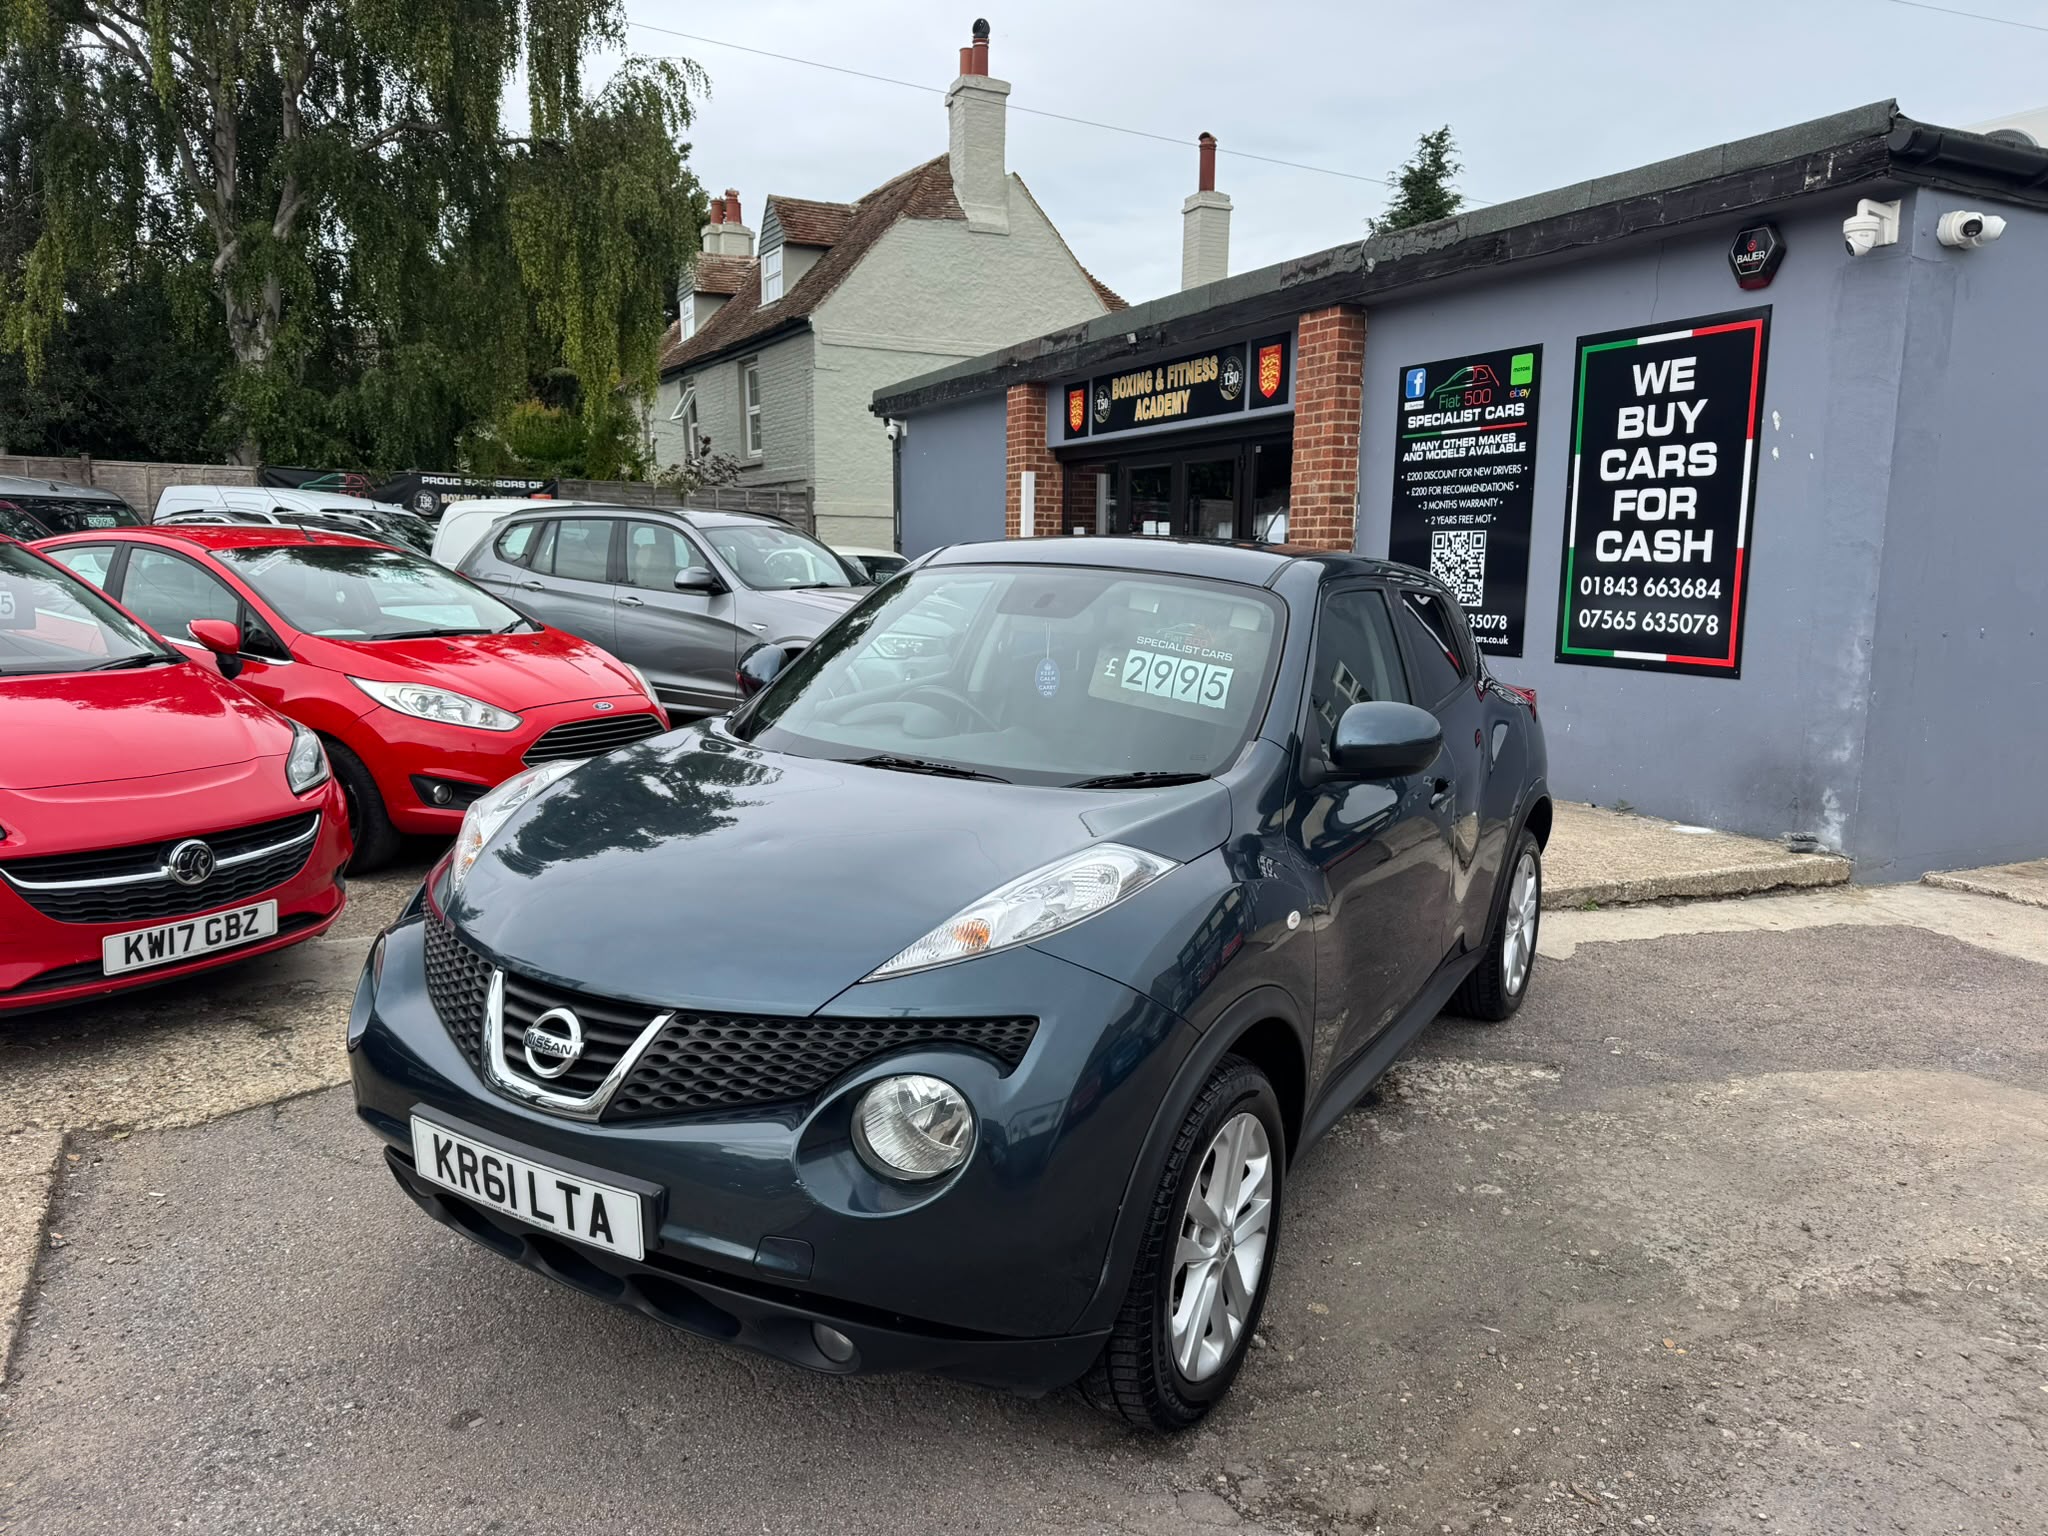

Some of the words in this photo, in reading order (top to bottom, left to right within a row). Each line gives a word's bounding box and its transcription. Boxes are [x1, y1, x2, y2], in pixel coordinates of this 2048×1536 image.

[1737, 250, 1766, 264] BAUER
[1111, 370, 1153, 401] BOXING
[1156, 368, 1165, 391] &
[1167, 355, 1219, 389] FITNESS
[1632, 356, 1697, 397] WE
[1134, 388, 1191, 422] ACADEMY
[1439, 393, 1460, 409] Fiat
[1464, 388, 1491, 406] 500
[1509, 388, 1531, 399] ebay
[1408, 408, 1481, 428] SPECIALIST
[1485, 403, 1525, 419] CARS
[1617, 399, 1709, 440] BUY
[1403, 451, 1424, 462] AND
[1425, 447, 1466, 460] MODELS
[1468, 442, 1526, 456] AVAILABLE
[1412, 440, 1440, 452] MANY
[1442, 437, 1476, 449] OTHER
[1479, 433, 1516, 445] MAKES
[1407, 472, 1423, 481] £200
[1423, 469, 1458, 480] DISCOUNT
[1458, 468, 1473, 477] FOR
[1474, 466, 1492, 476] NEW
[1492, 464, 1522, 475] DRIVERS
[1599, 441, 1718, 481] CARS
[421, 476, 461, 486] PROUD
[528, 481, 544, 489] OF
[1411, 487, 1428, 496] £200
[1428, 486, 1442, 495] FOR
[1443, 481, 1514, 494] RECOMMENDATIONS
[1423, 501, 1428, 510] 3
[1428, 500, 1458, 509] MONTHS
[1459, 498, 1499, 508] WARRANTY
[1612, 487, 1698, 521] FOR
[1430, 516, 1436, 525] 2
[1436, 515, 1457, 525] YEARS
[1458, 515, 1474, 524] FREE
[1475, 514, 1492, 523] MOT
[1595, 529, 1714, 563] CASH
[1580, 576, 1638, 596] 01843
[1643, 578, 1721, 599] 663684
[1468, 613, 1508, 630] 35078
[1579, 609, 1637, 630] 07565
[1641, 612, 1719, 636] 635078
[1136, 635, 1201, 655] SPECIALIST
[1201, 648, 1233, 661] CARS
[124, 923, 195, 965] KW17
[205, 908, 259, 946] GBZ
[526, 1032, 573, 1055] NISSAN
[433, 1133, 517, 1210] KR61
[527, 1170, 614, 1244] LTA
